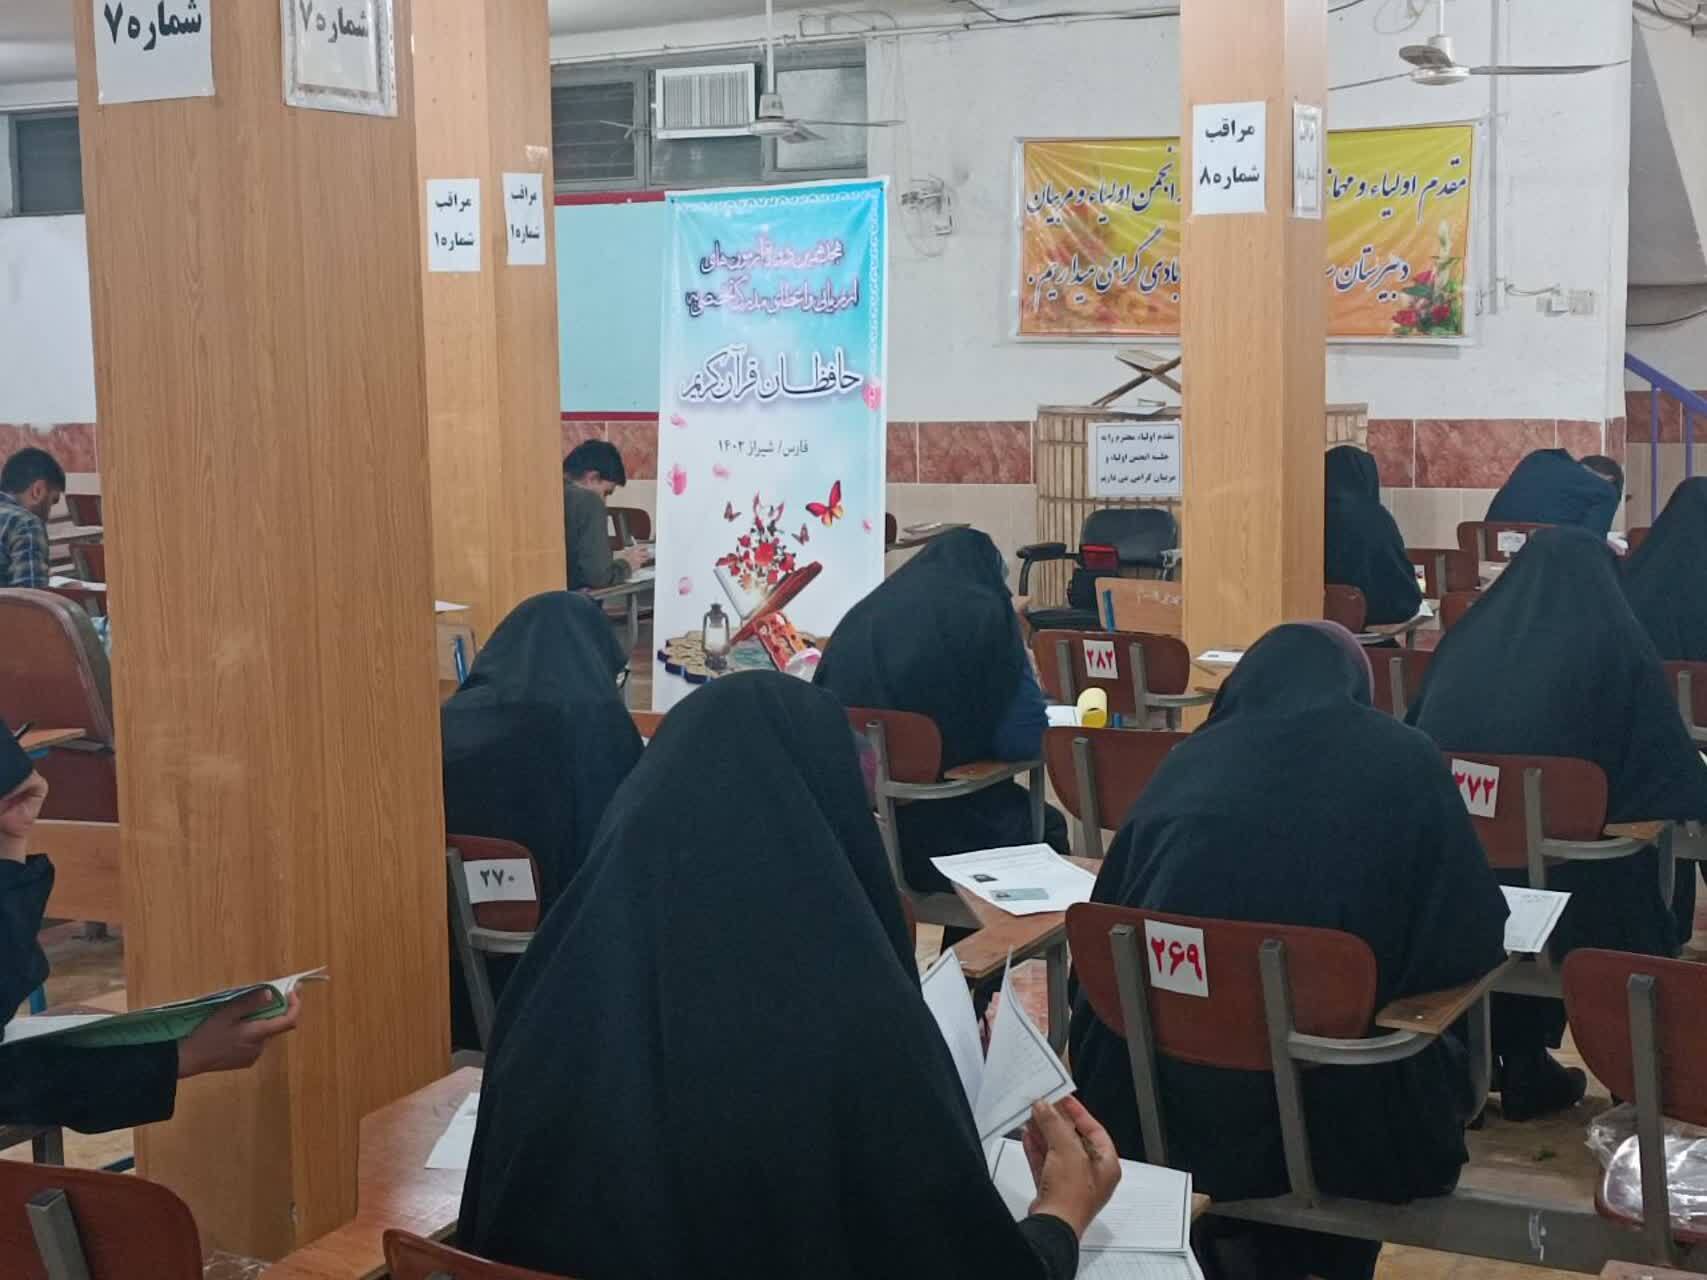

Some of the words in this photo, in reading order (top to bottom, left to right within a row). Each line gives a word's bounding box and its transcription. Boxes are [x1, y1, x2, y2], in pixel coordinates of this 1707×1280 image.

[1205, 118, 1256, 143] مراقب
[510, 184, 537, 206] مراقب
[1074, 188, 1086, 204] و
[1131, 146, 1177, 212] انجمن
[1355, 181, 1366, 198] و
[1371, 171, 1416, 217] اولیاء
[1417, 157, 1467, 224] مقدم
[435, 191, 472, 212] مراقب
[1026, 183, 1074, 222] مربیان
[1088, 182, 1130, 222] اولیاء
[1095, 226, 1163, 291] گرامی
[1335, 246, 1409, 299] دبیرستان
[681, 350, 733, 399] کریم
[711, 349, 758, 399] قرآن
[757, 349, 862, 399] حافظان
[747, 439, 774, 457] شیراز
[479, 868, 515, 888] ۲۷۰
[1150, 935, 1204, 982] ۲۶۹
